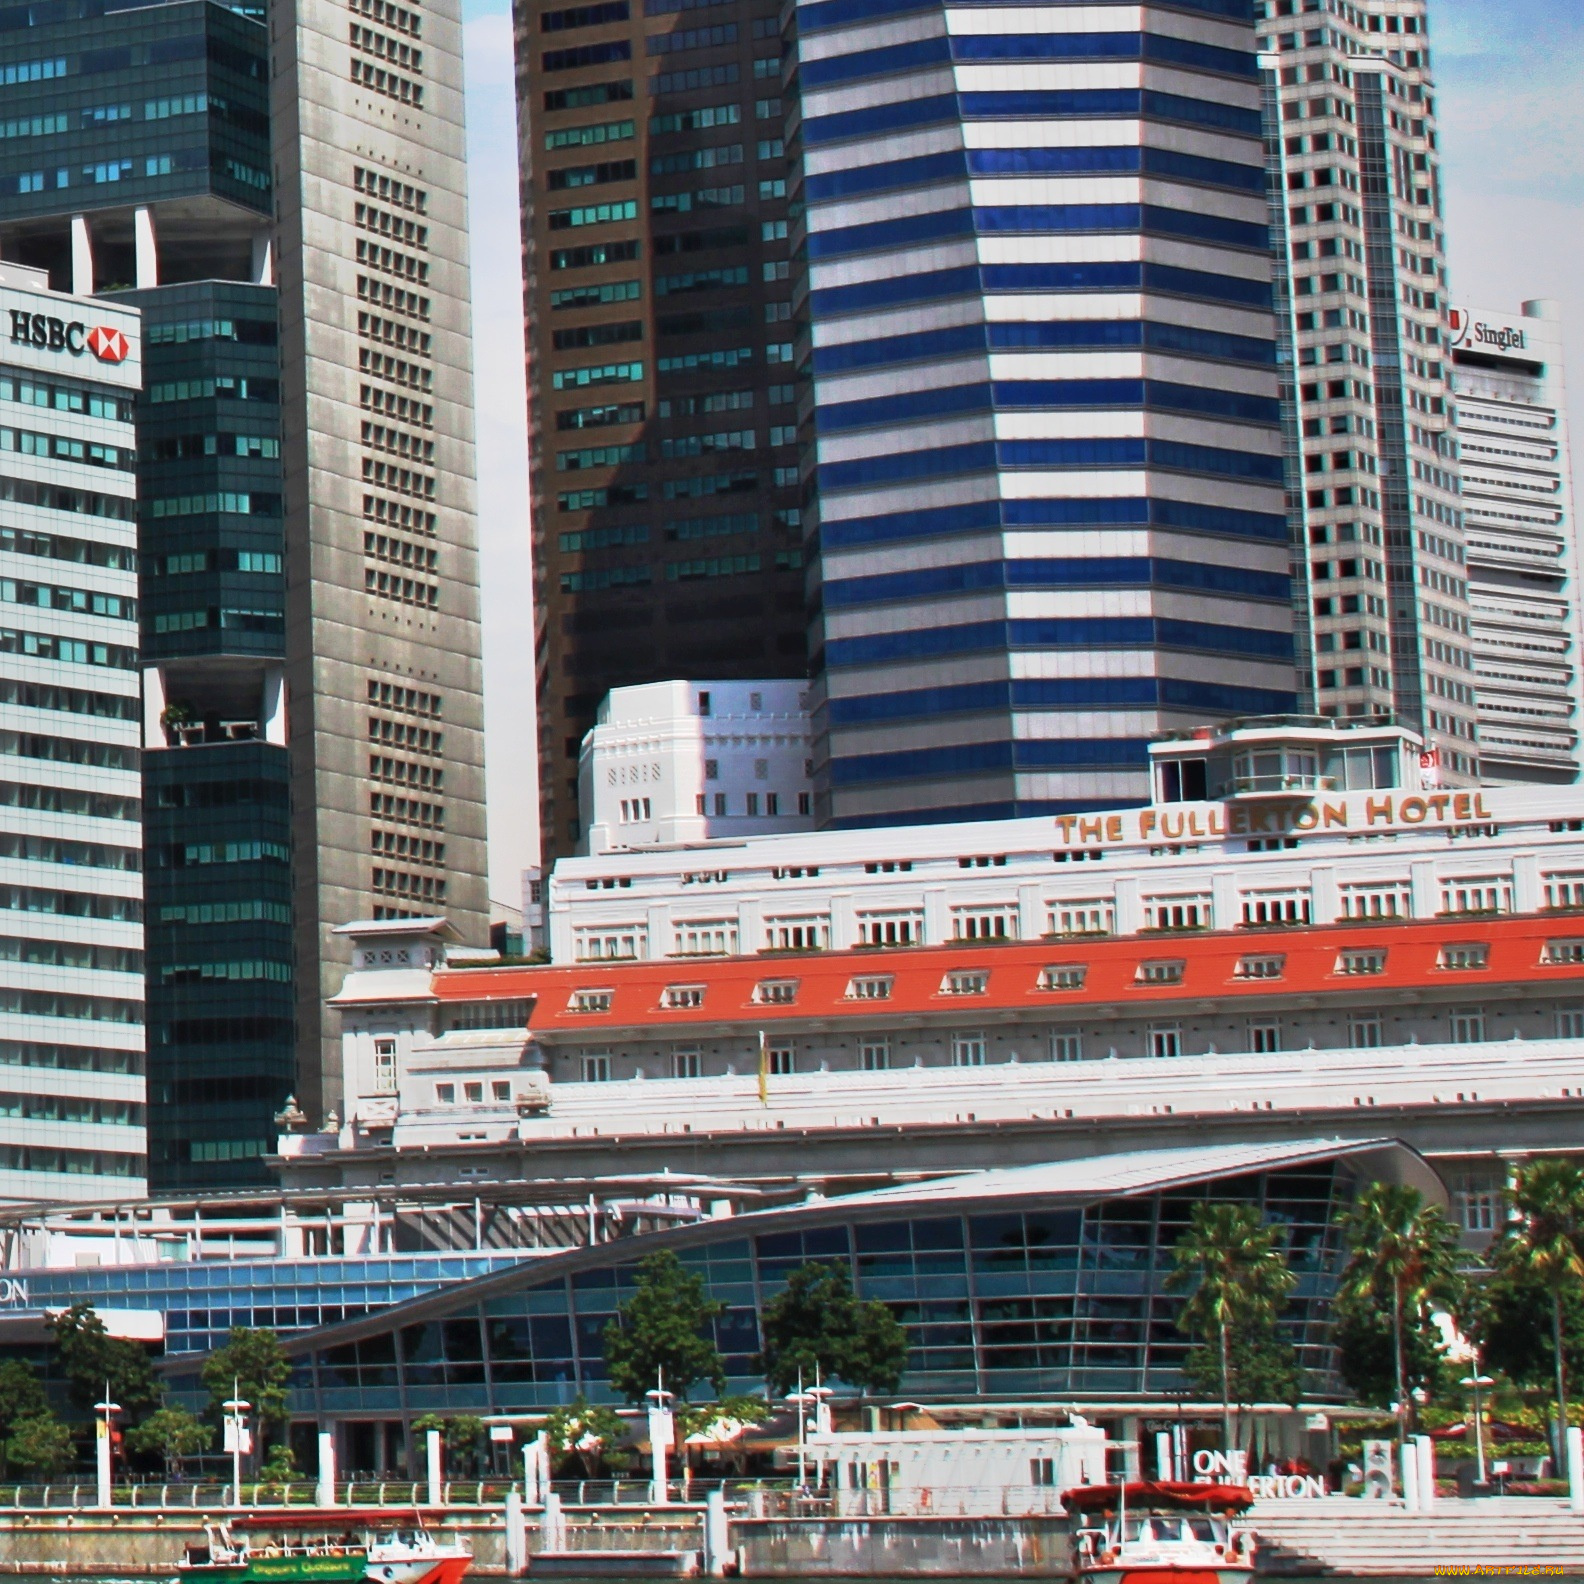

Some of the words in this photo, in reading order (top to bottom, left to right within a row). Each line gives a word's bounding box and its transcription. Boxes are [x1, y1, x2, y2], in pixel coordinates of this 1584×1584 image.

[8, 308, 85, 355] HSBC
[1474, 321, 1525, 352] SingTel
[1054, 814, 1124, 845] THE
[1138, 800, 1347, 840] FULLERTON
[1365, 791, 1492, 826] HOTEL
[1193, 1449, 1247, 1474] ONE
